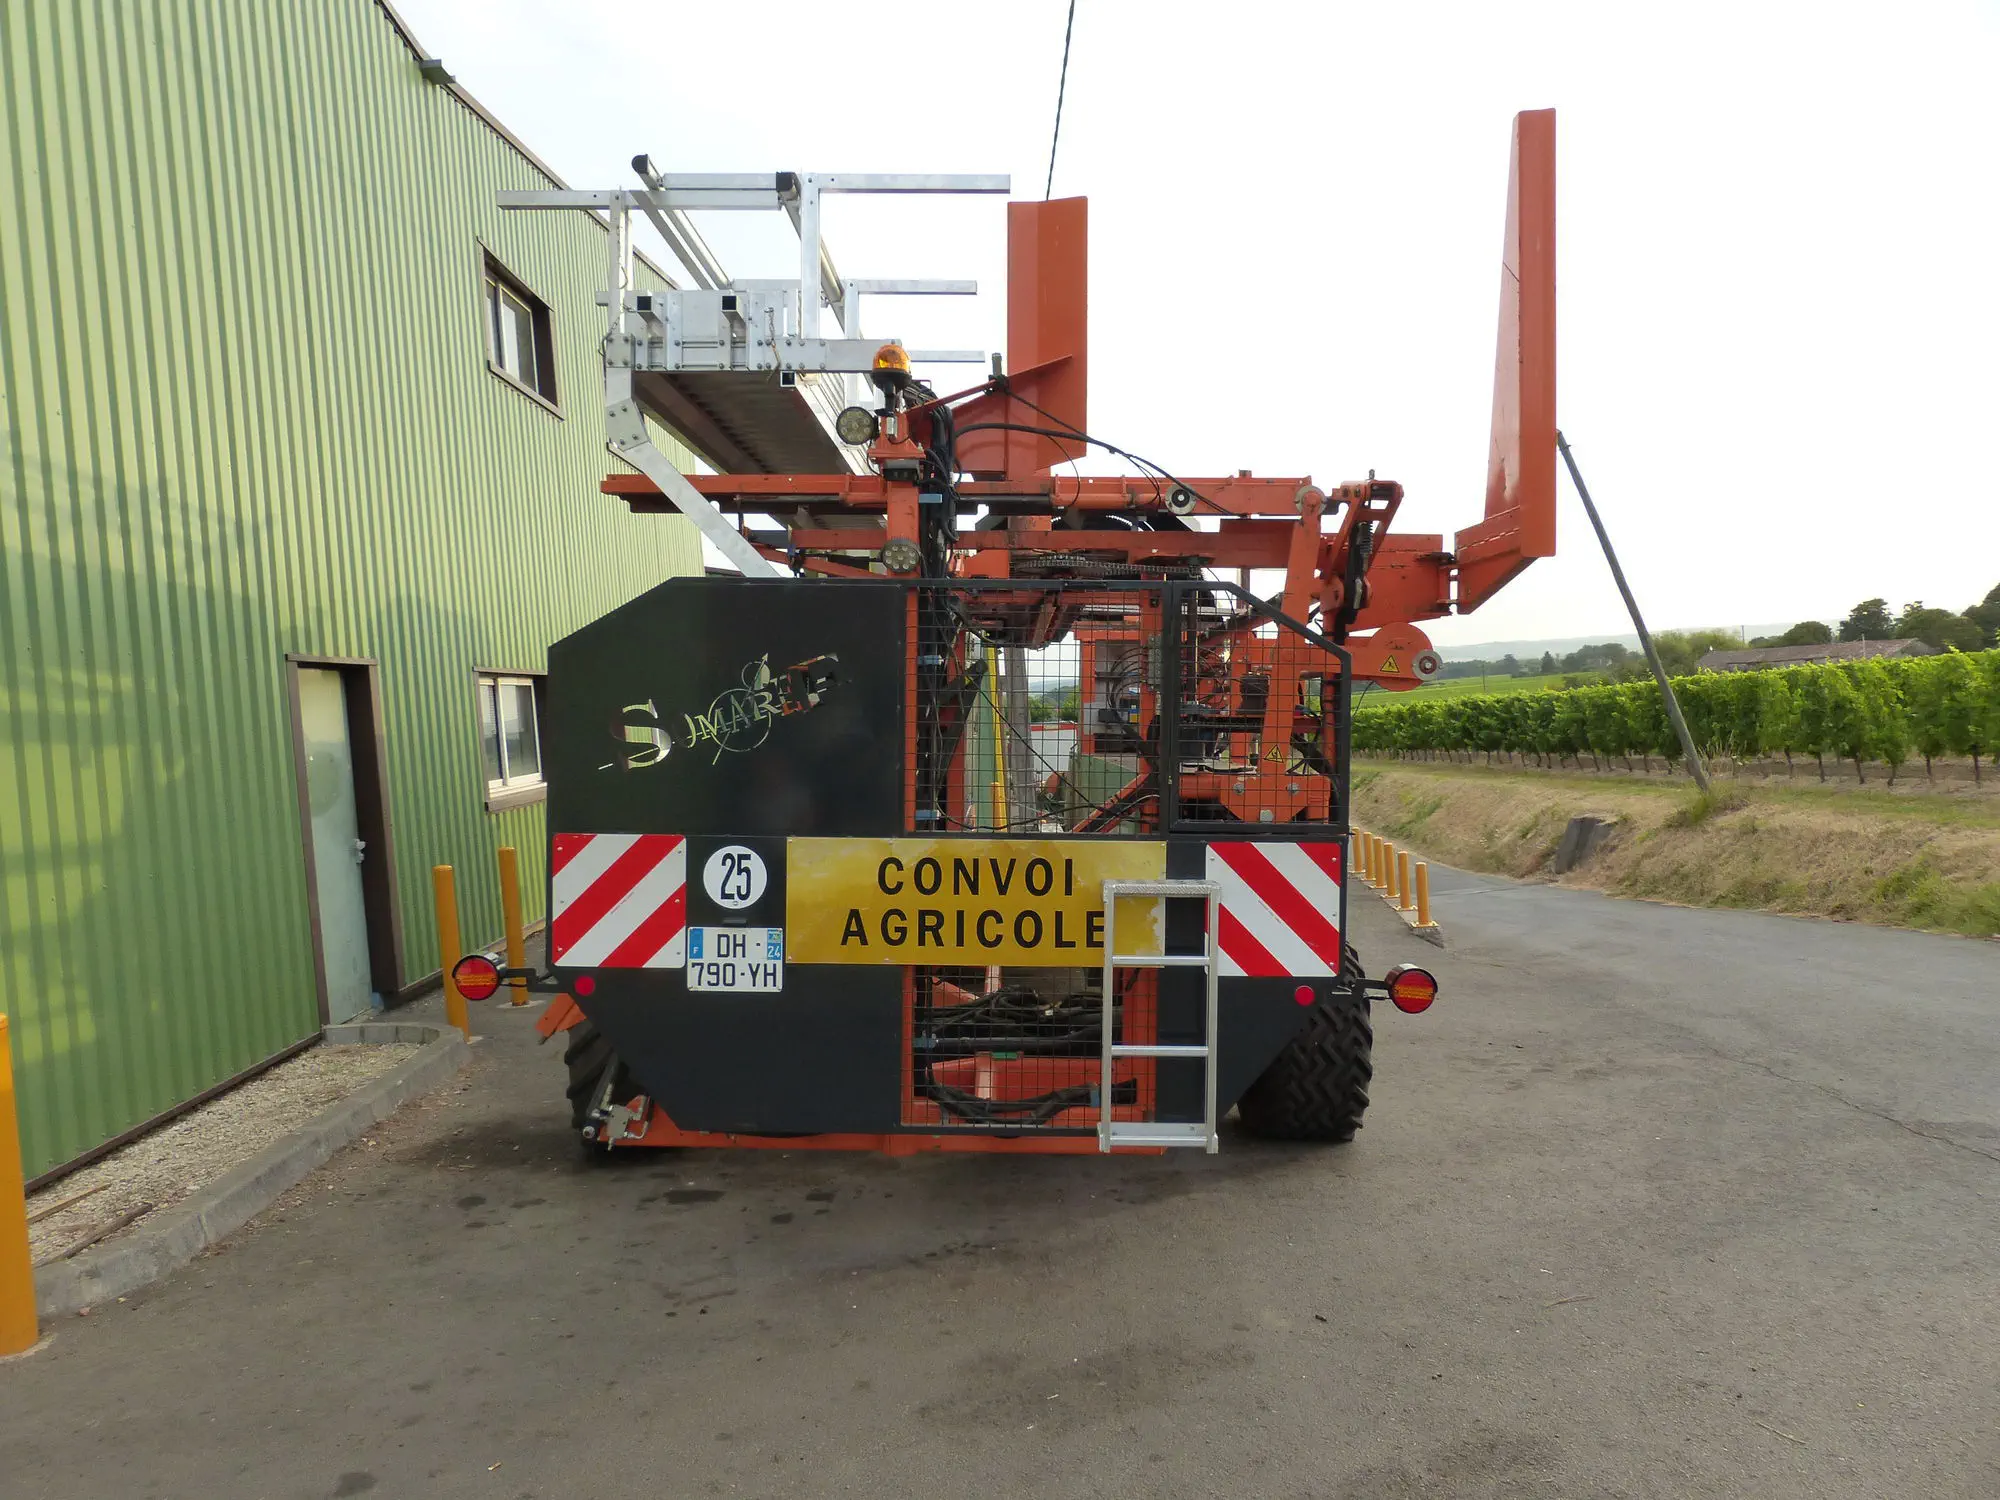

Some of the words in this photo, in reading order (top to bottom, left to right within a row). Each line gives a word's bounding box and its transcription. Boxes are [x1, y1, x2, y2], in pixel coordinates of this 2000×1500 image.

[721, 853, 752, 901] 25
[877, 857, 1073, 896] CONVOI
[840, 908, 1104, 949] AGRICOLE
[693, 946, 699, 954] F
[767, 945, 781, 958] 24
[691, 962, 777, 987] 790-YH
